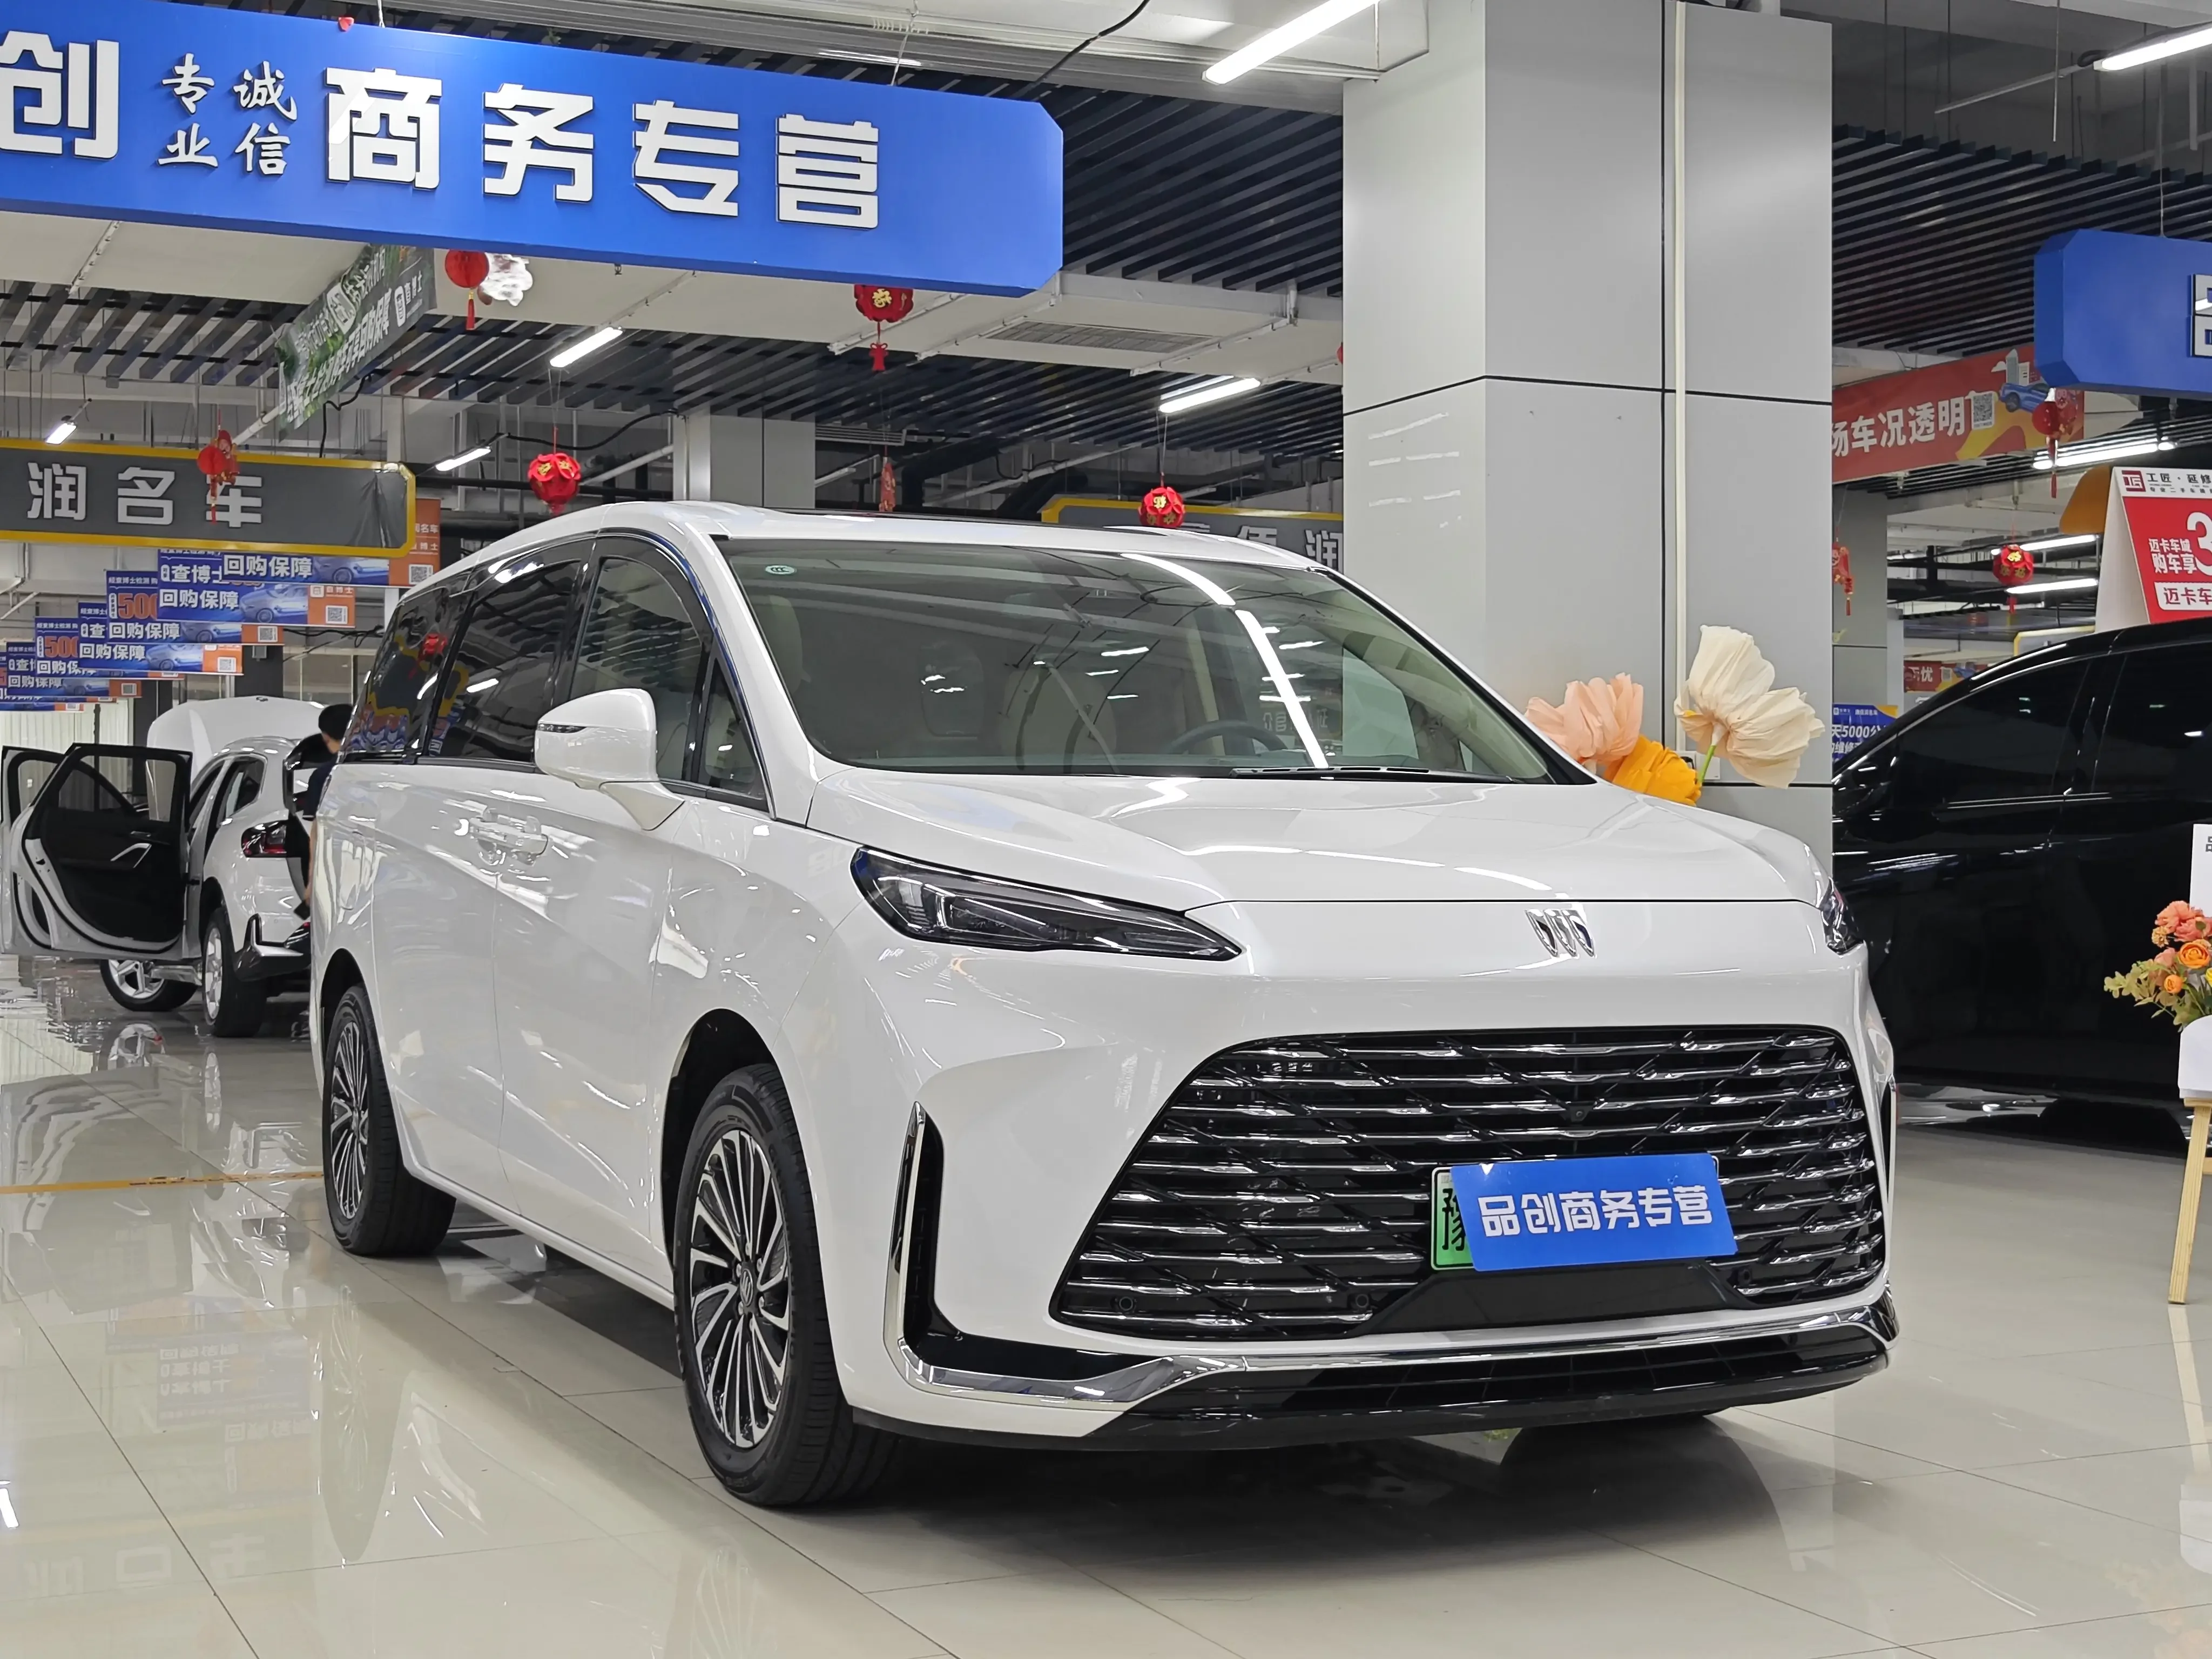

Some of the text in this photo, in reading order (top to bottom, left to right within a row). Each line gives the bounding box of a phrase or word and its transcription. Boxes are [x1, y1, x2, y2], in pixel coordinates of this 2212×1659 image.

[0, 30, 119, 159] 创
[326, 67, 878, 228] 商务专营
[27, 462, 262, 528] 润名车
[224, 554, 312, 578] 回购保障
[159, 589, 239, 610] 回购保障
[109, 622, 180, 640] 回购保障
[79, 643, 146, 661] 回购保障
[37, 660, 96, 675] 回购保
[8, 675, 62, 688] 回购保障
[1478, 1185, 1712, 1237] 品创商务专营
